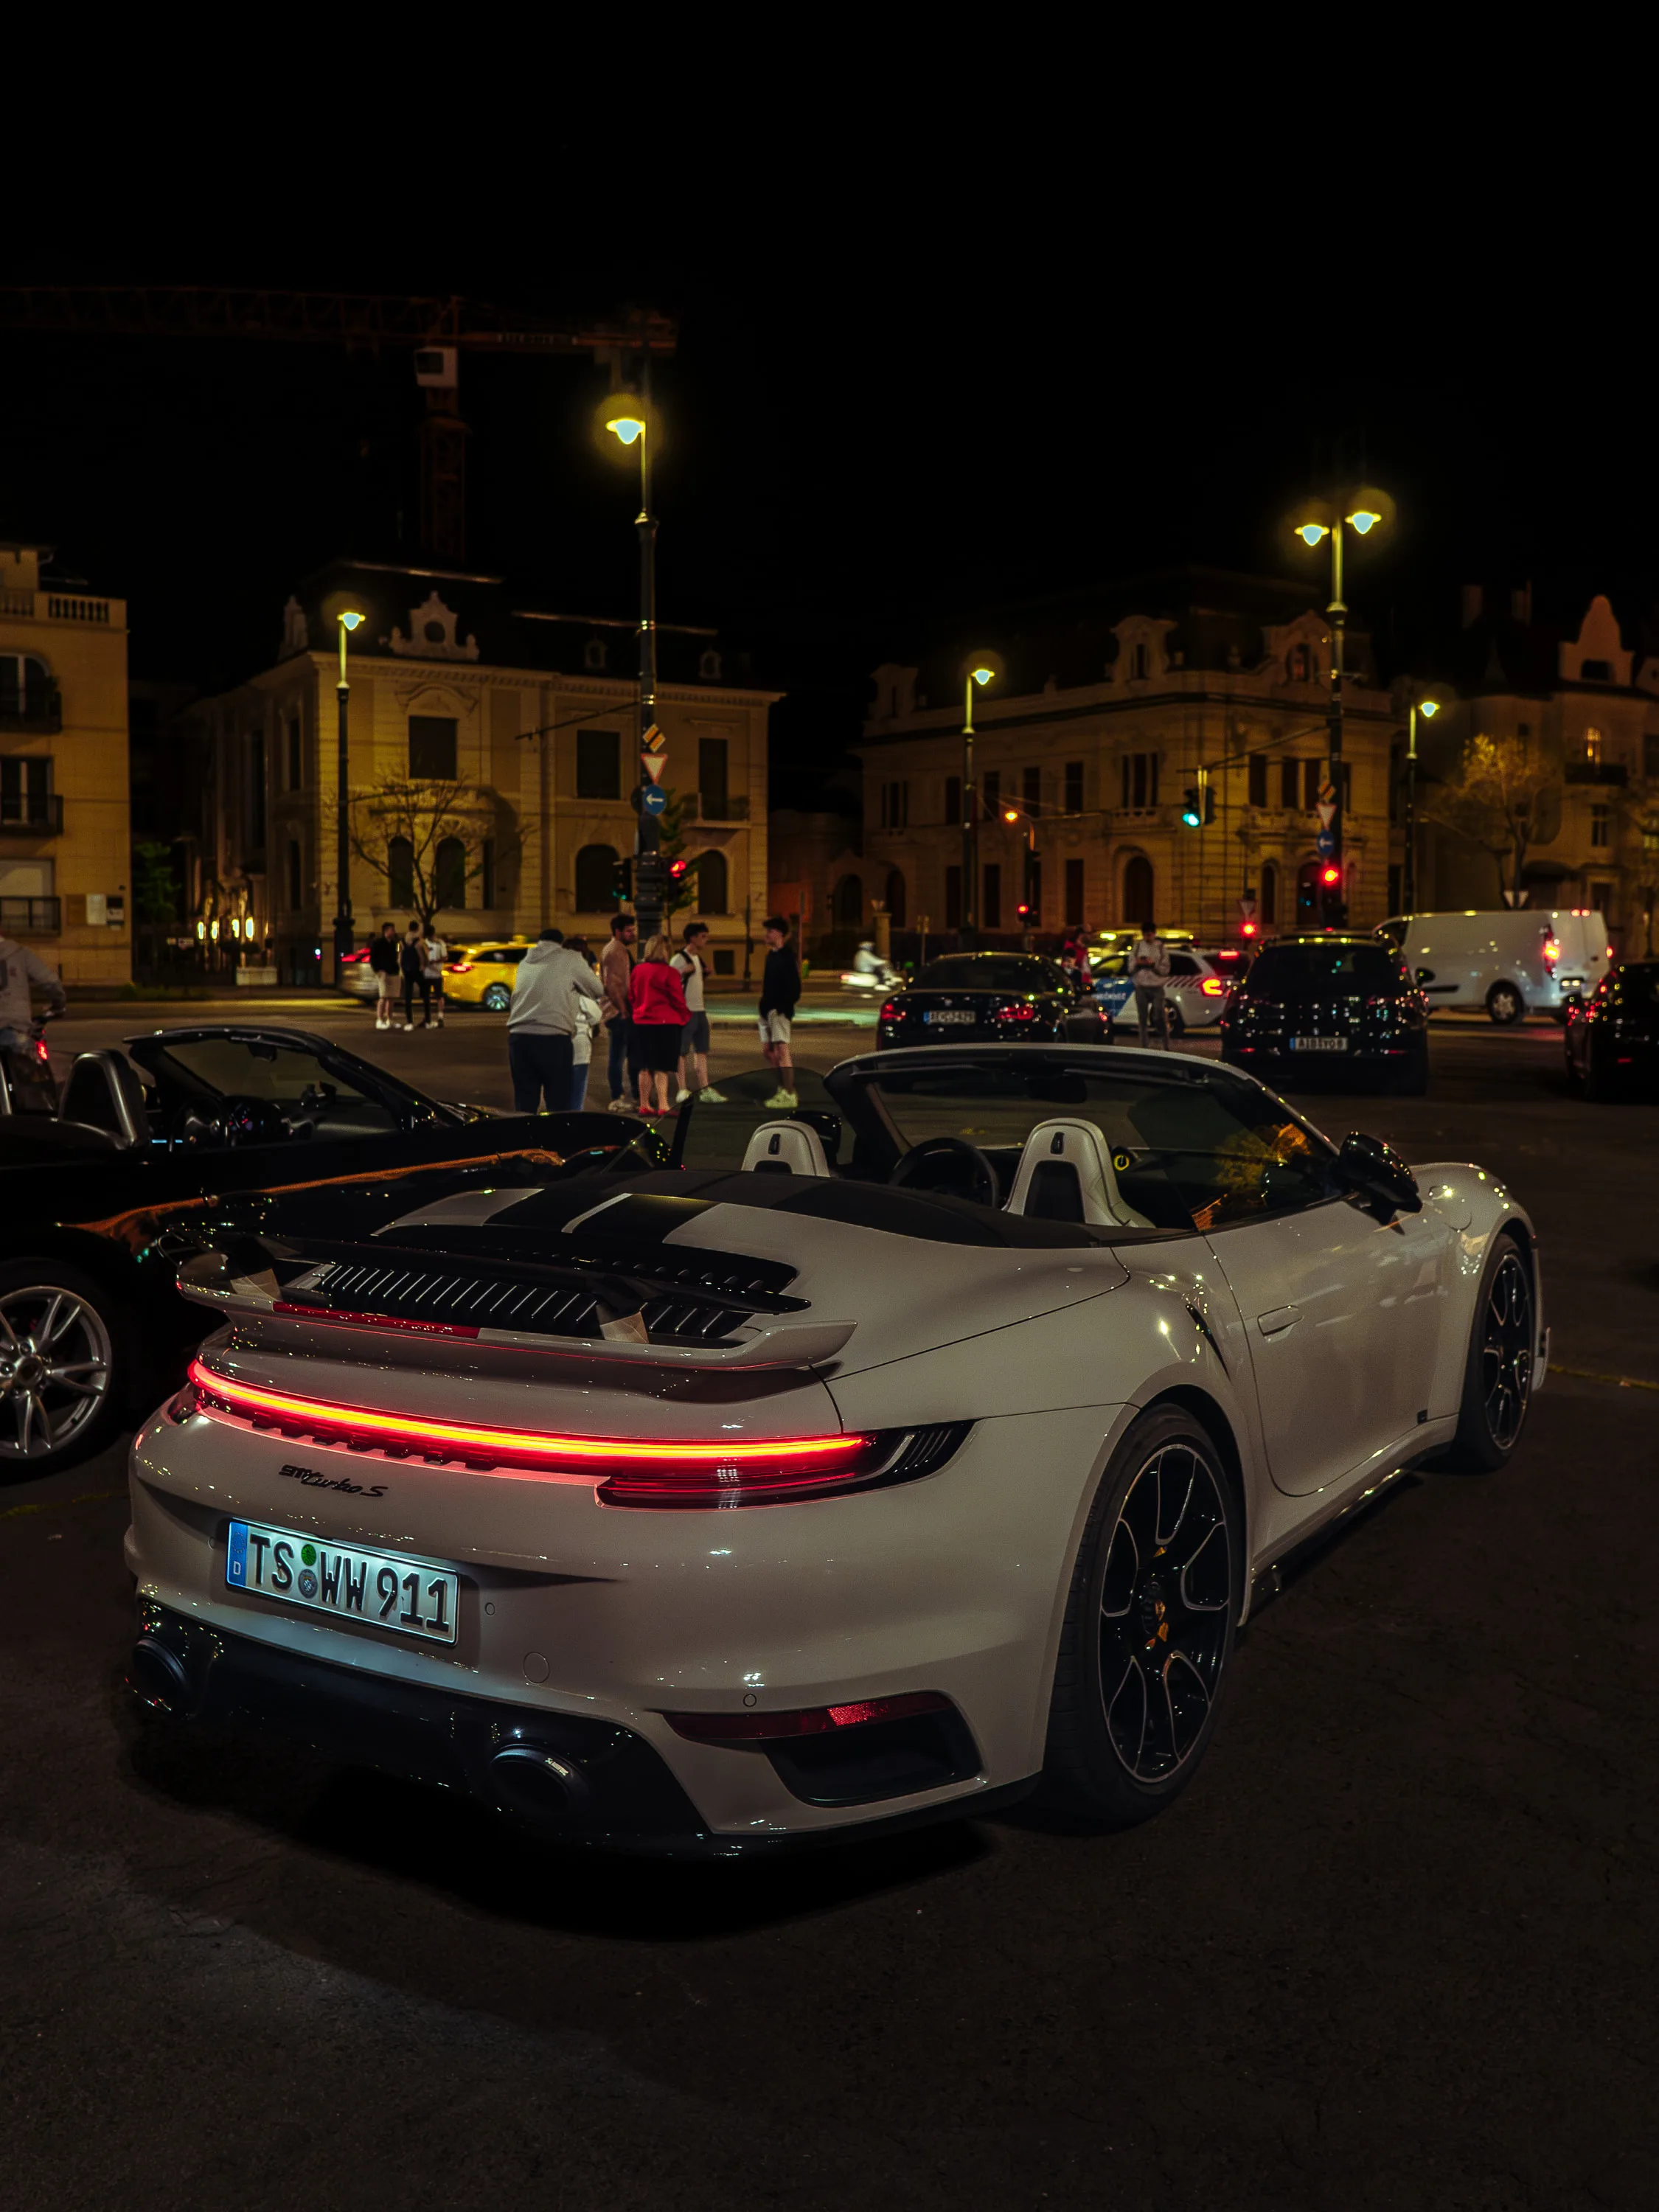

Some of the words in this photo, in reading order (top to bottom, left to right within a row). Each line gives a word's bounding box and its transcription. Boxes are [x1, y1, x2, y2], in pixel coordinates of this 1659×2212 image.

[360, 1486, 388, 1497] S
[233, 1561, 241, 1575] D
[251, 1534, 294, 1590] TS
[320, 1551, 366, 1611] WW
[377, 1568, 449, 1632] 911
